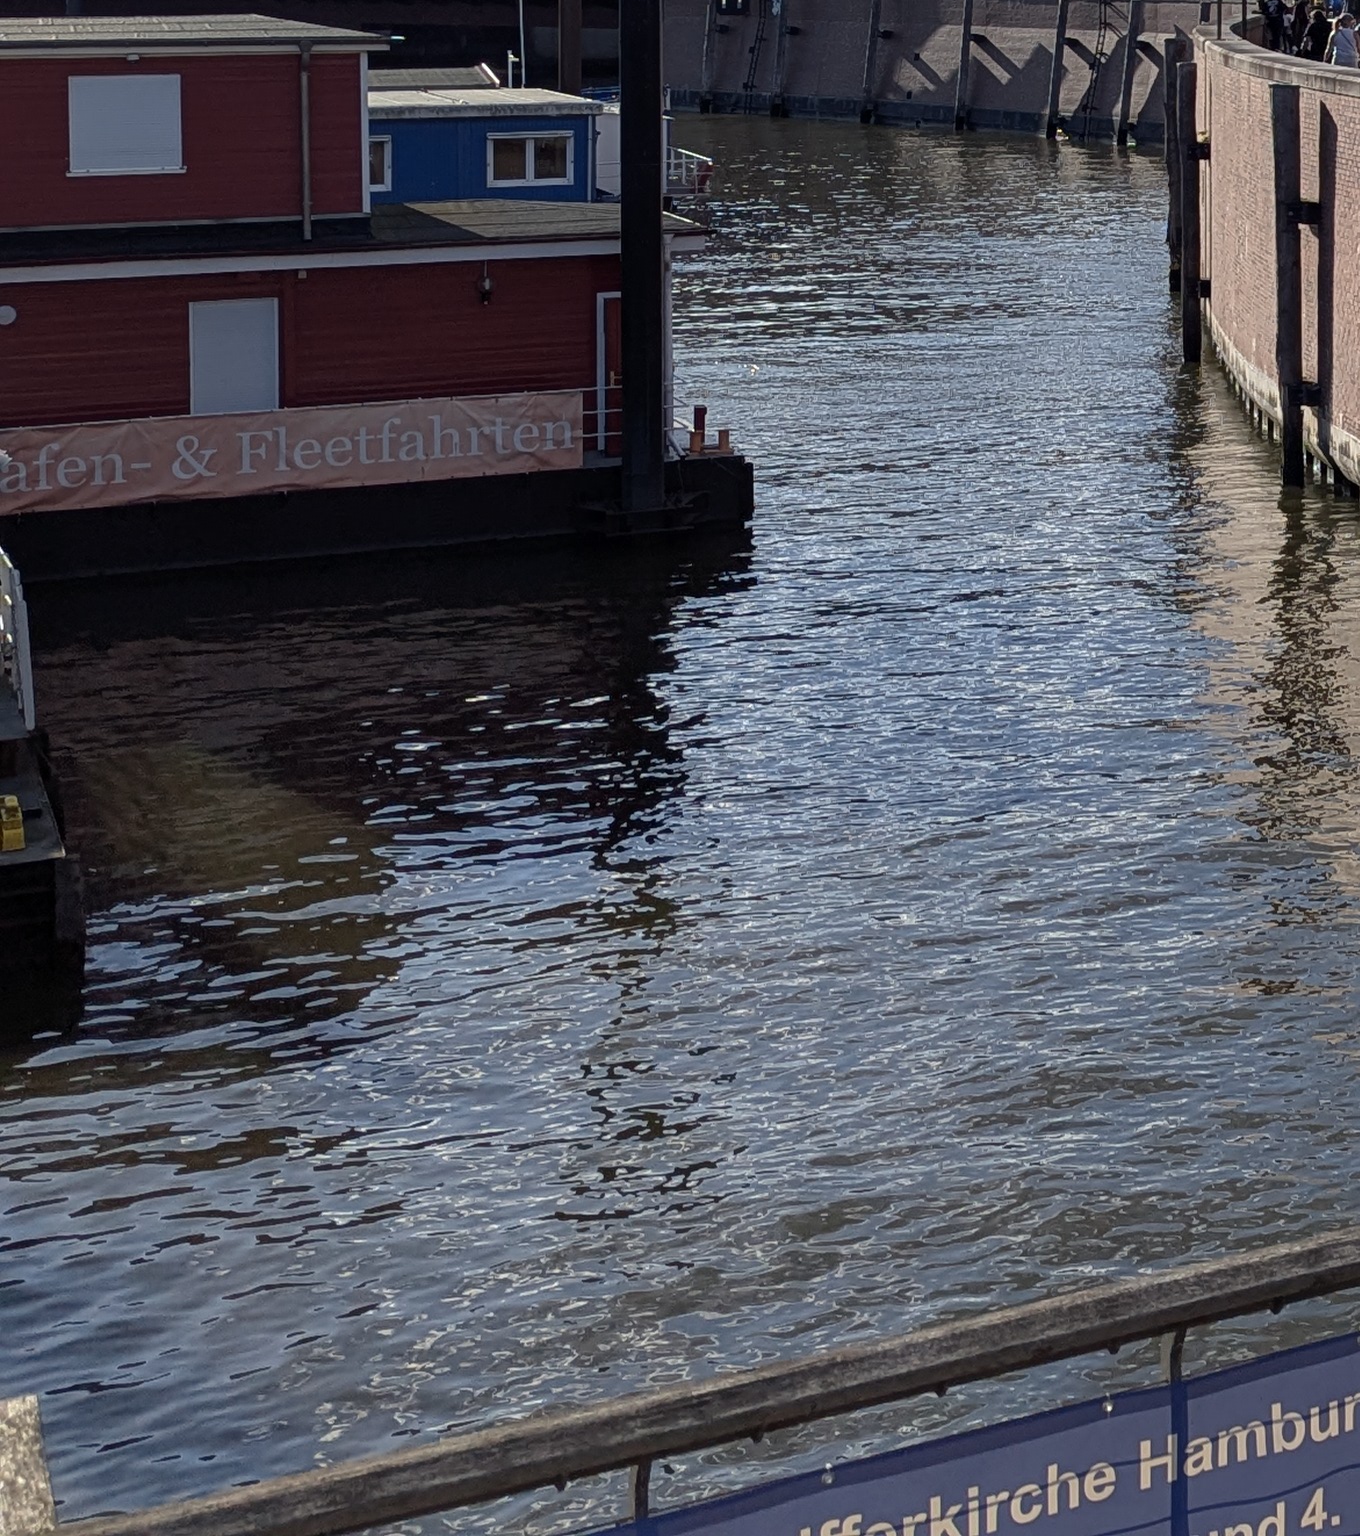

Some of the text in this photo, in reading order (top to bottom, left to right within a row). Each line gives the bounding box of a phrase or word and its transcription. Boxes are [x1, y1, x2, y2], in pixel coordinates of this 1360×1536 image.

[172, 434, 218, 480] &
[236, 415, 575, 474] Fleetfahrten
[1300, 1486, 1341, 1531] 4.
